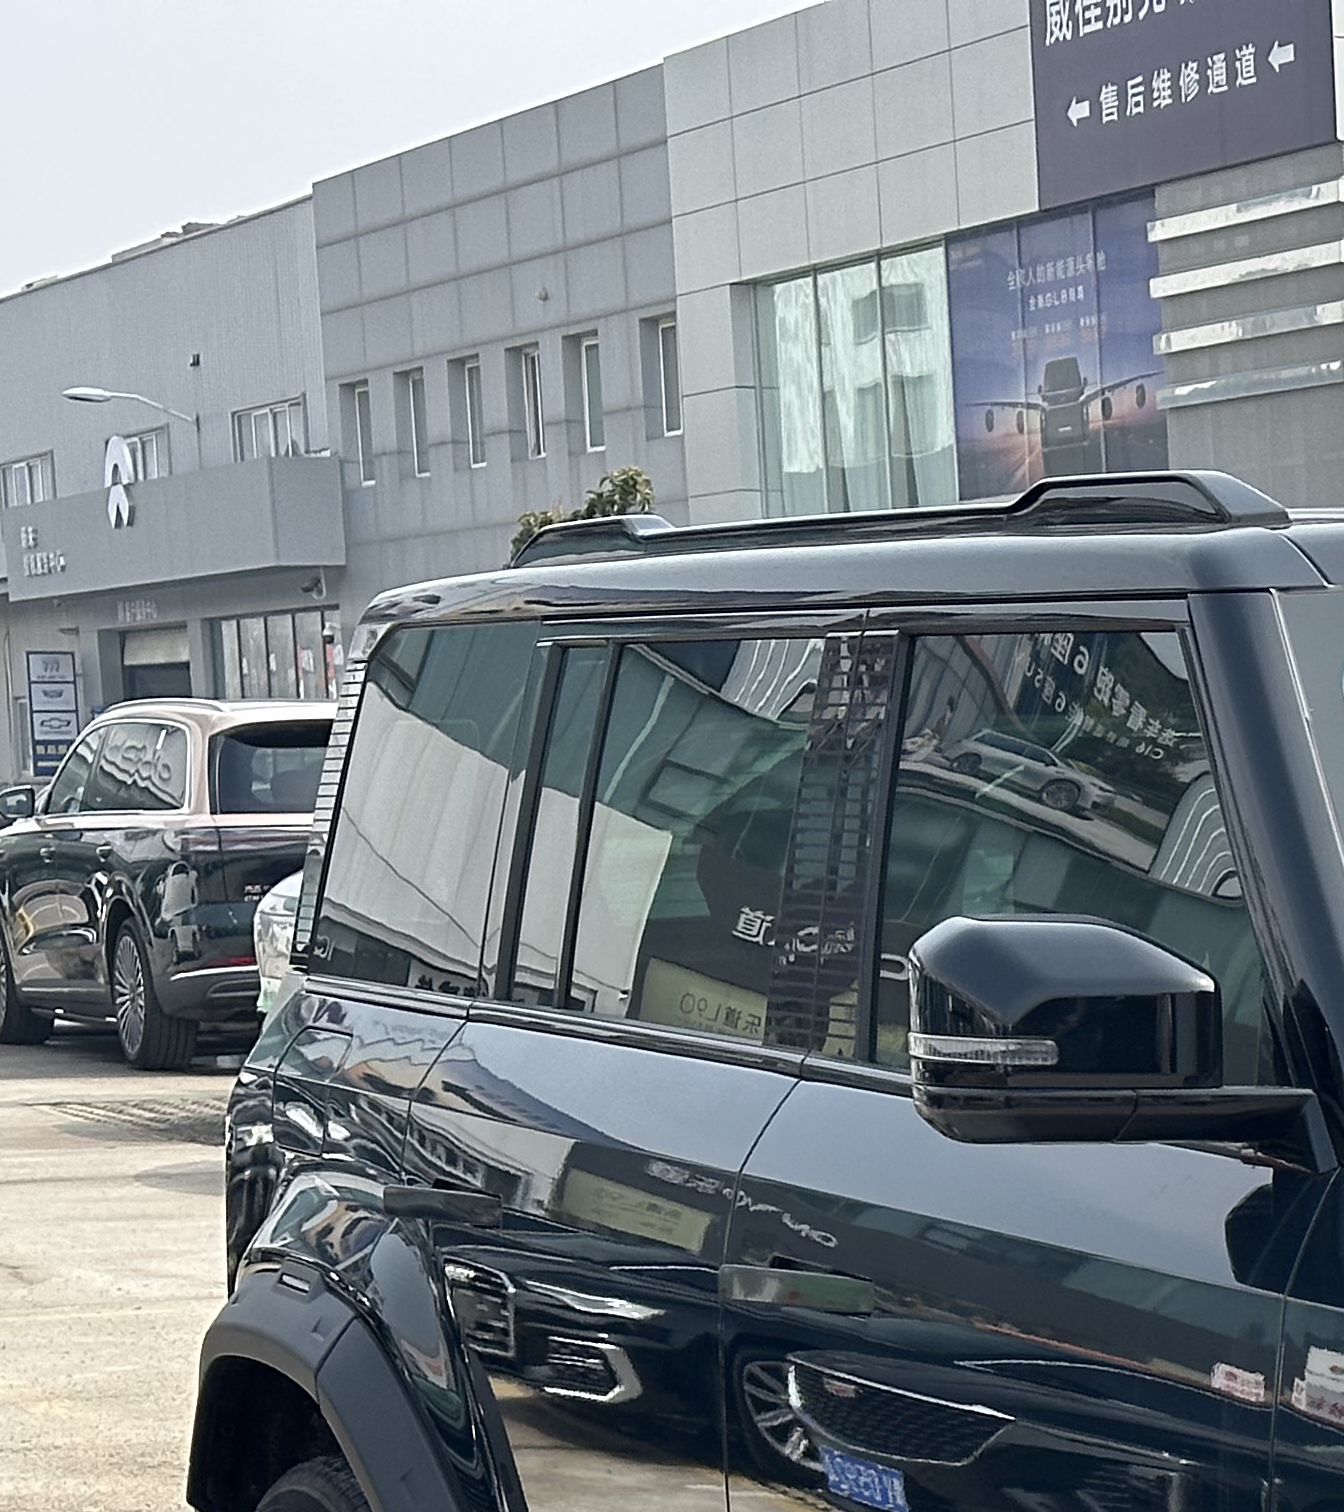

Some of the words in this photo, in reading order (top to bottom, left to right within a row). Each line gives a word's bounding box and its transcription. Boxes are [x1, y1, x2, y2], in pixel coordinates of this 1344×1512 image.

[1099, 43, 1258, 124] 售后维修通道
